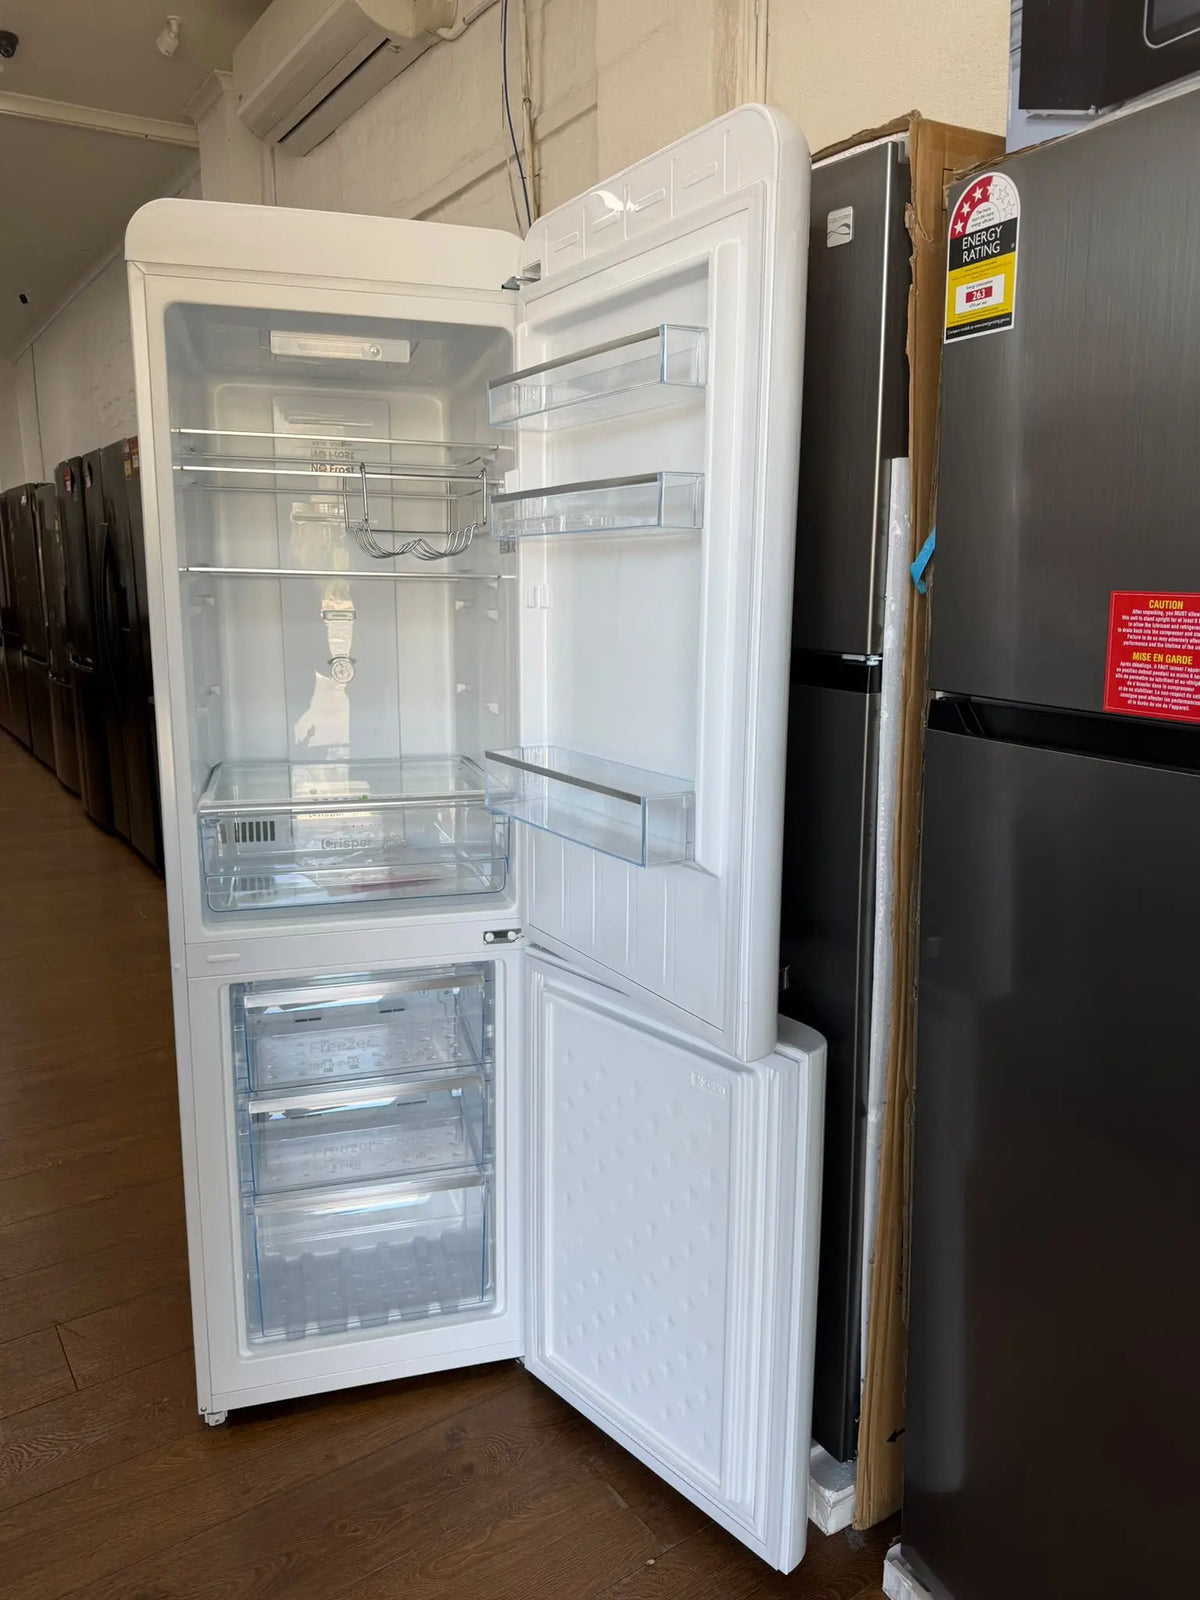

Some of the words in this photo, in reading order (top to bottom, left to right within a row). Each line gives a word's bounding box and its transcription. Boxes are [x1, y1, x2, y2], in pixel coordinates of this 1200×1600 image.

[962, 225, 1002, 250] ENERGY
[962, 240, 1000, 264] RATING
[972, 288, 986, 300] 263
[330, 464, 355, 473] Frost
[1149, 600, 1184, 610] CAUTION
[1132, 652, 1152, 661] MISE
[1154, 653, 1163, 662] EN
[1166, 655, 1193, 665] GARDE
[310, 1038, 371, 1054] Freezer
